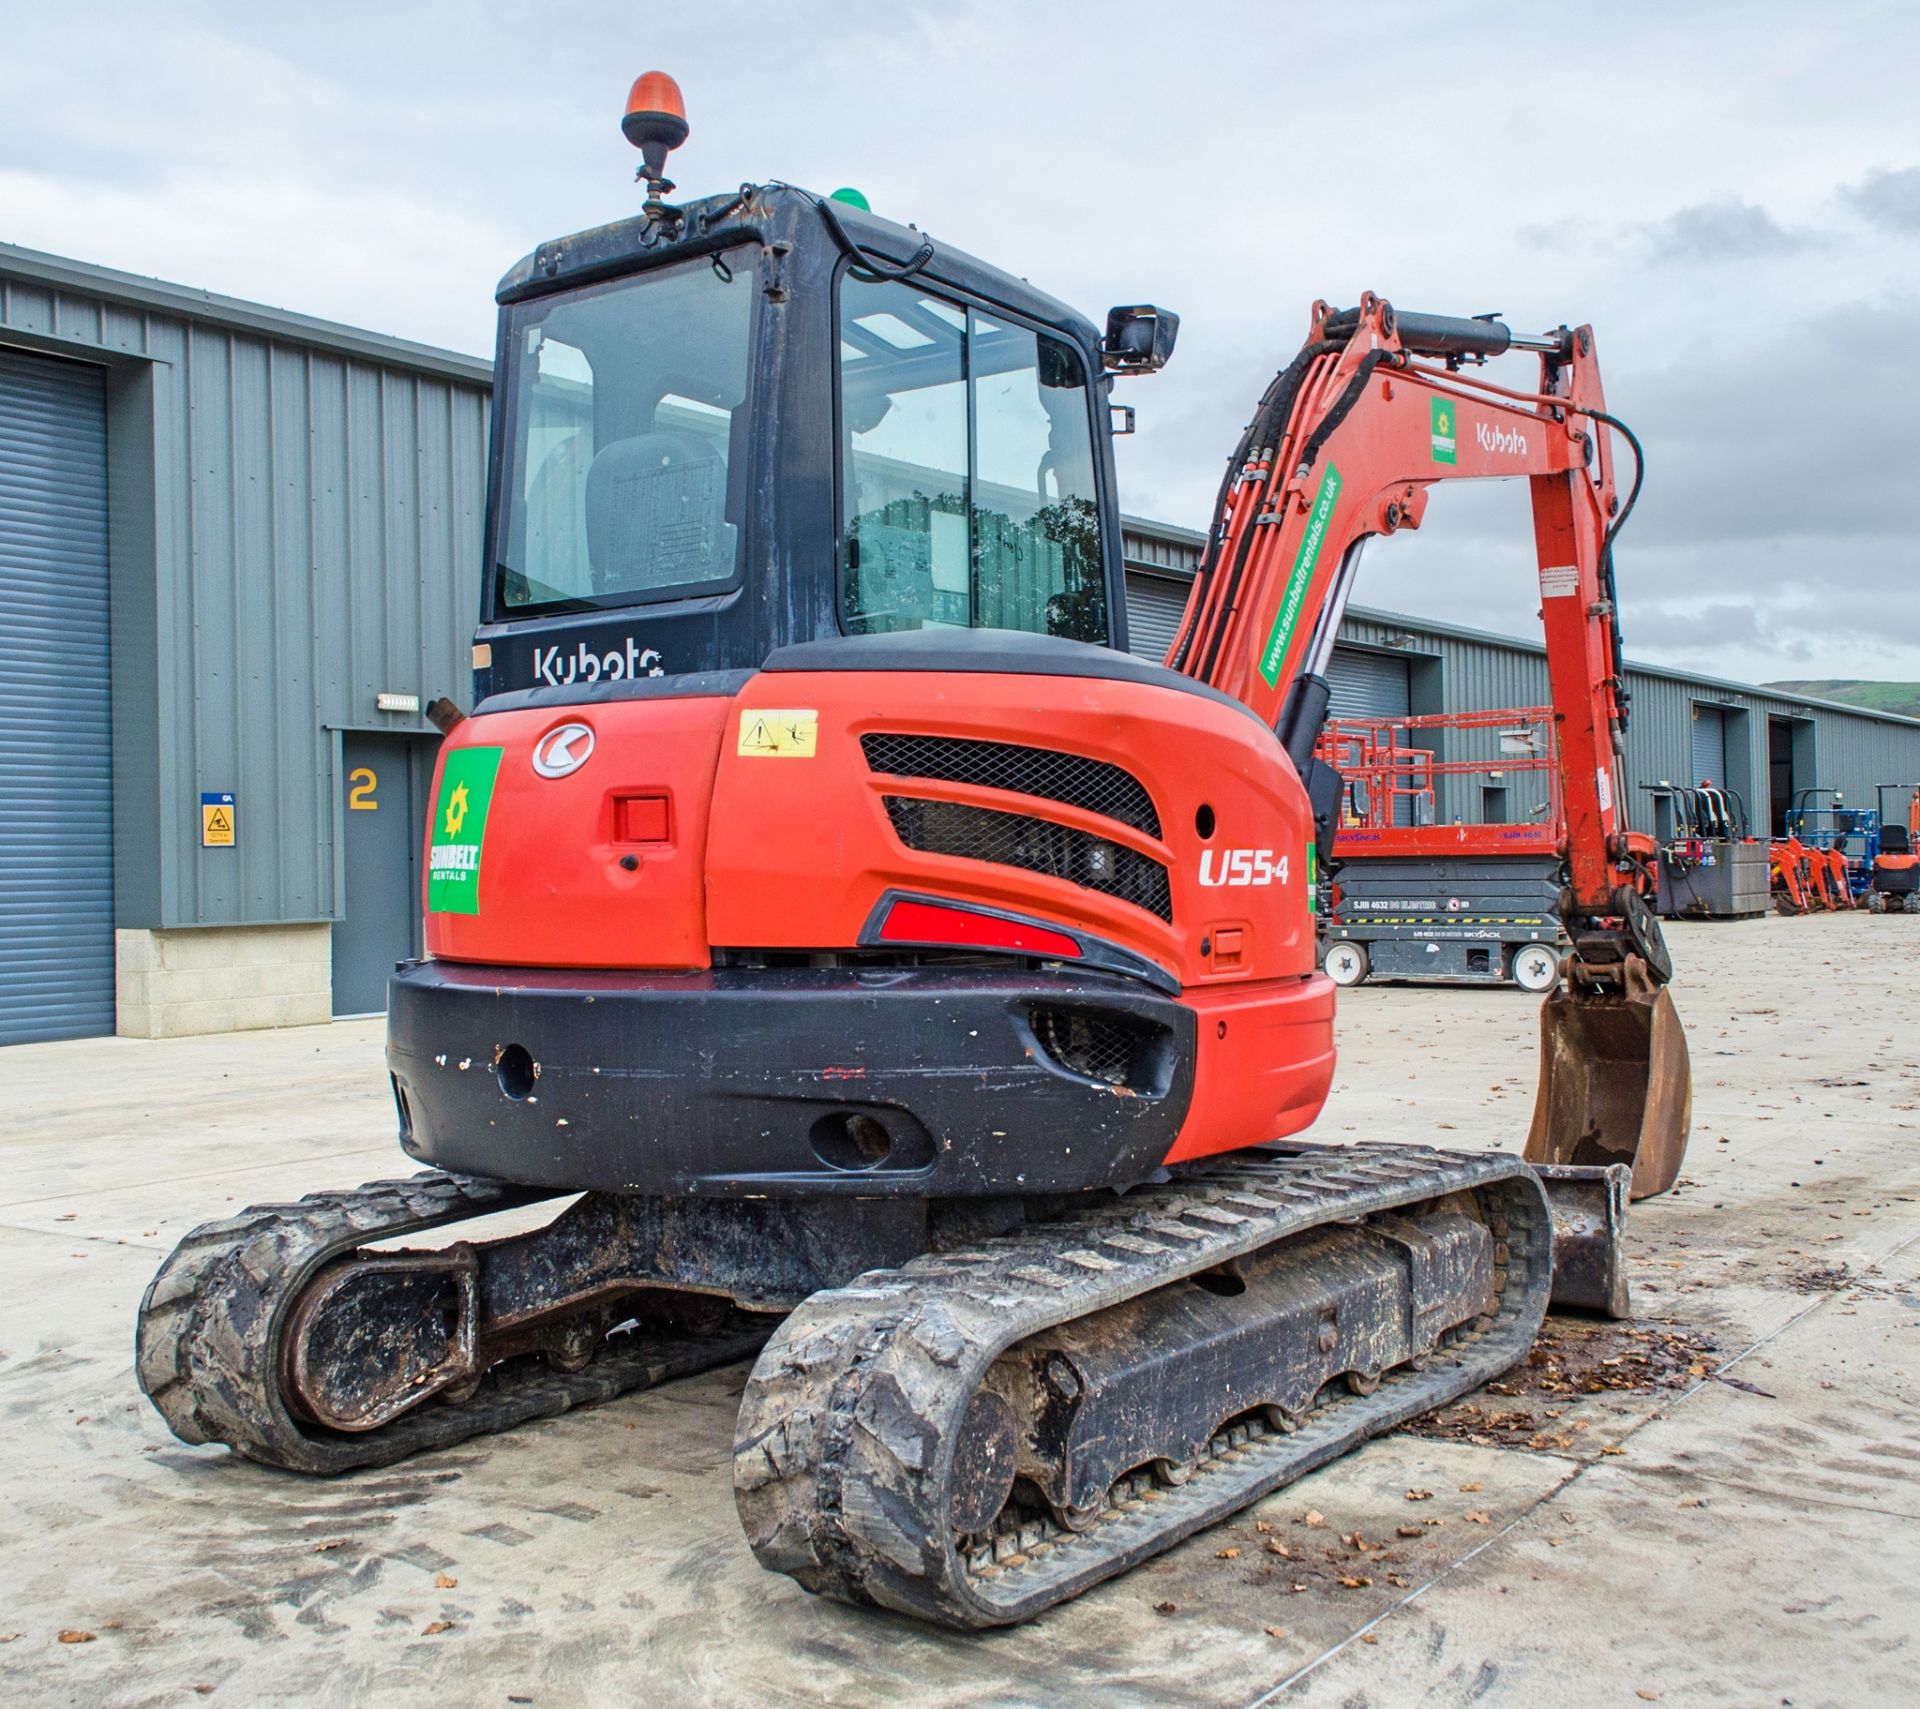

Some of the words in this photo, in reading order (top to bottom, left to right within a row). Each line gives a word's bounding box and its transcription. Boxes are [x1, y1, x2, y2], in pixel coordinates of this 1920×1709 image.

[1476, 422, 1527, 455] Kubota
[1267, 476, 1337, 673] www.sunbeltrentals.co.uk
[350, 767, 377, 810] 2
[430, 844, 479, 870] SUNBELT
[433, 870, 466, 881] RENTALS
[1371, 900, 1389, 910] 4632
[1463, 929, 1501, 939] SKYJACK
